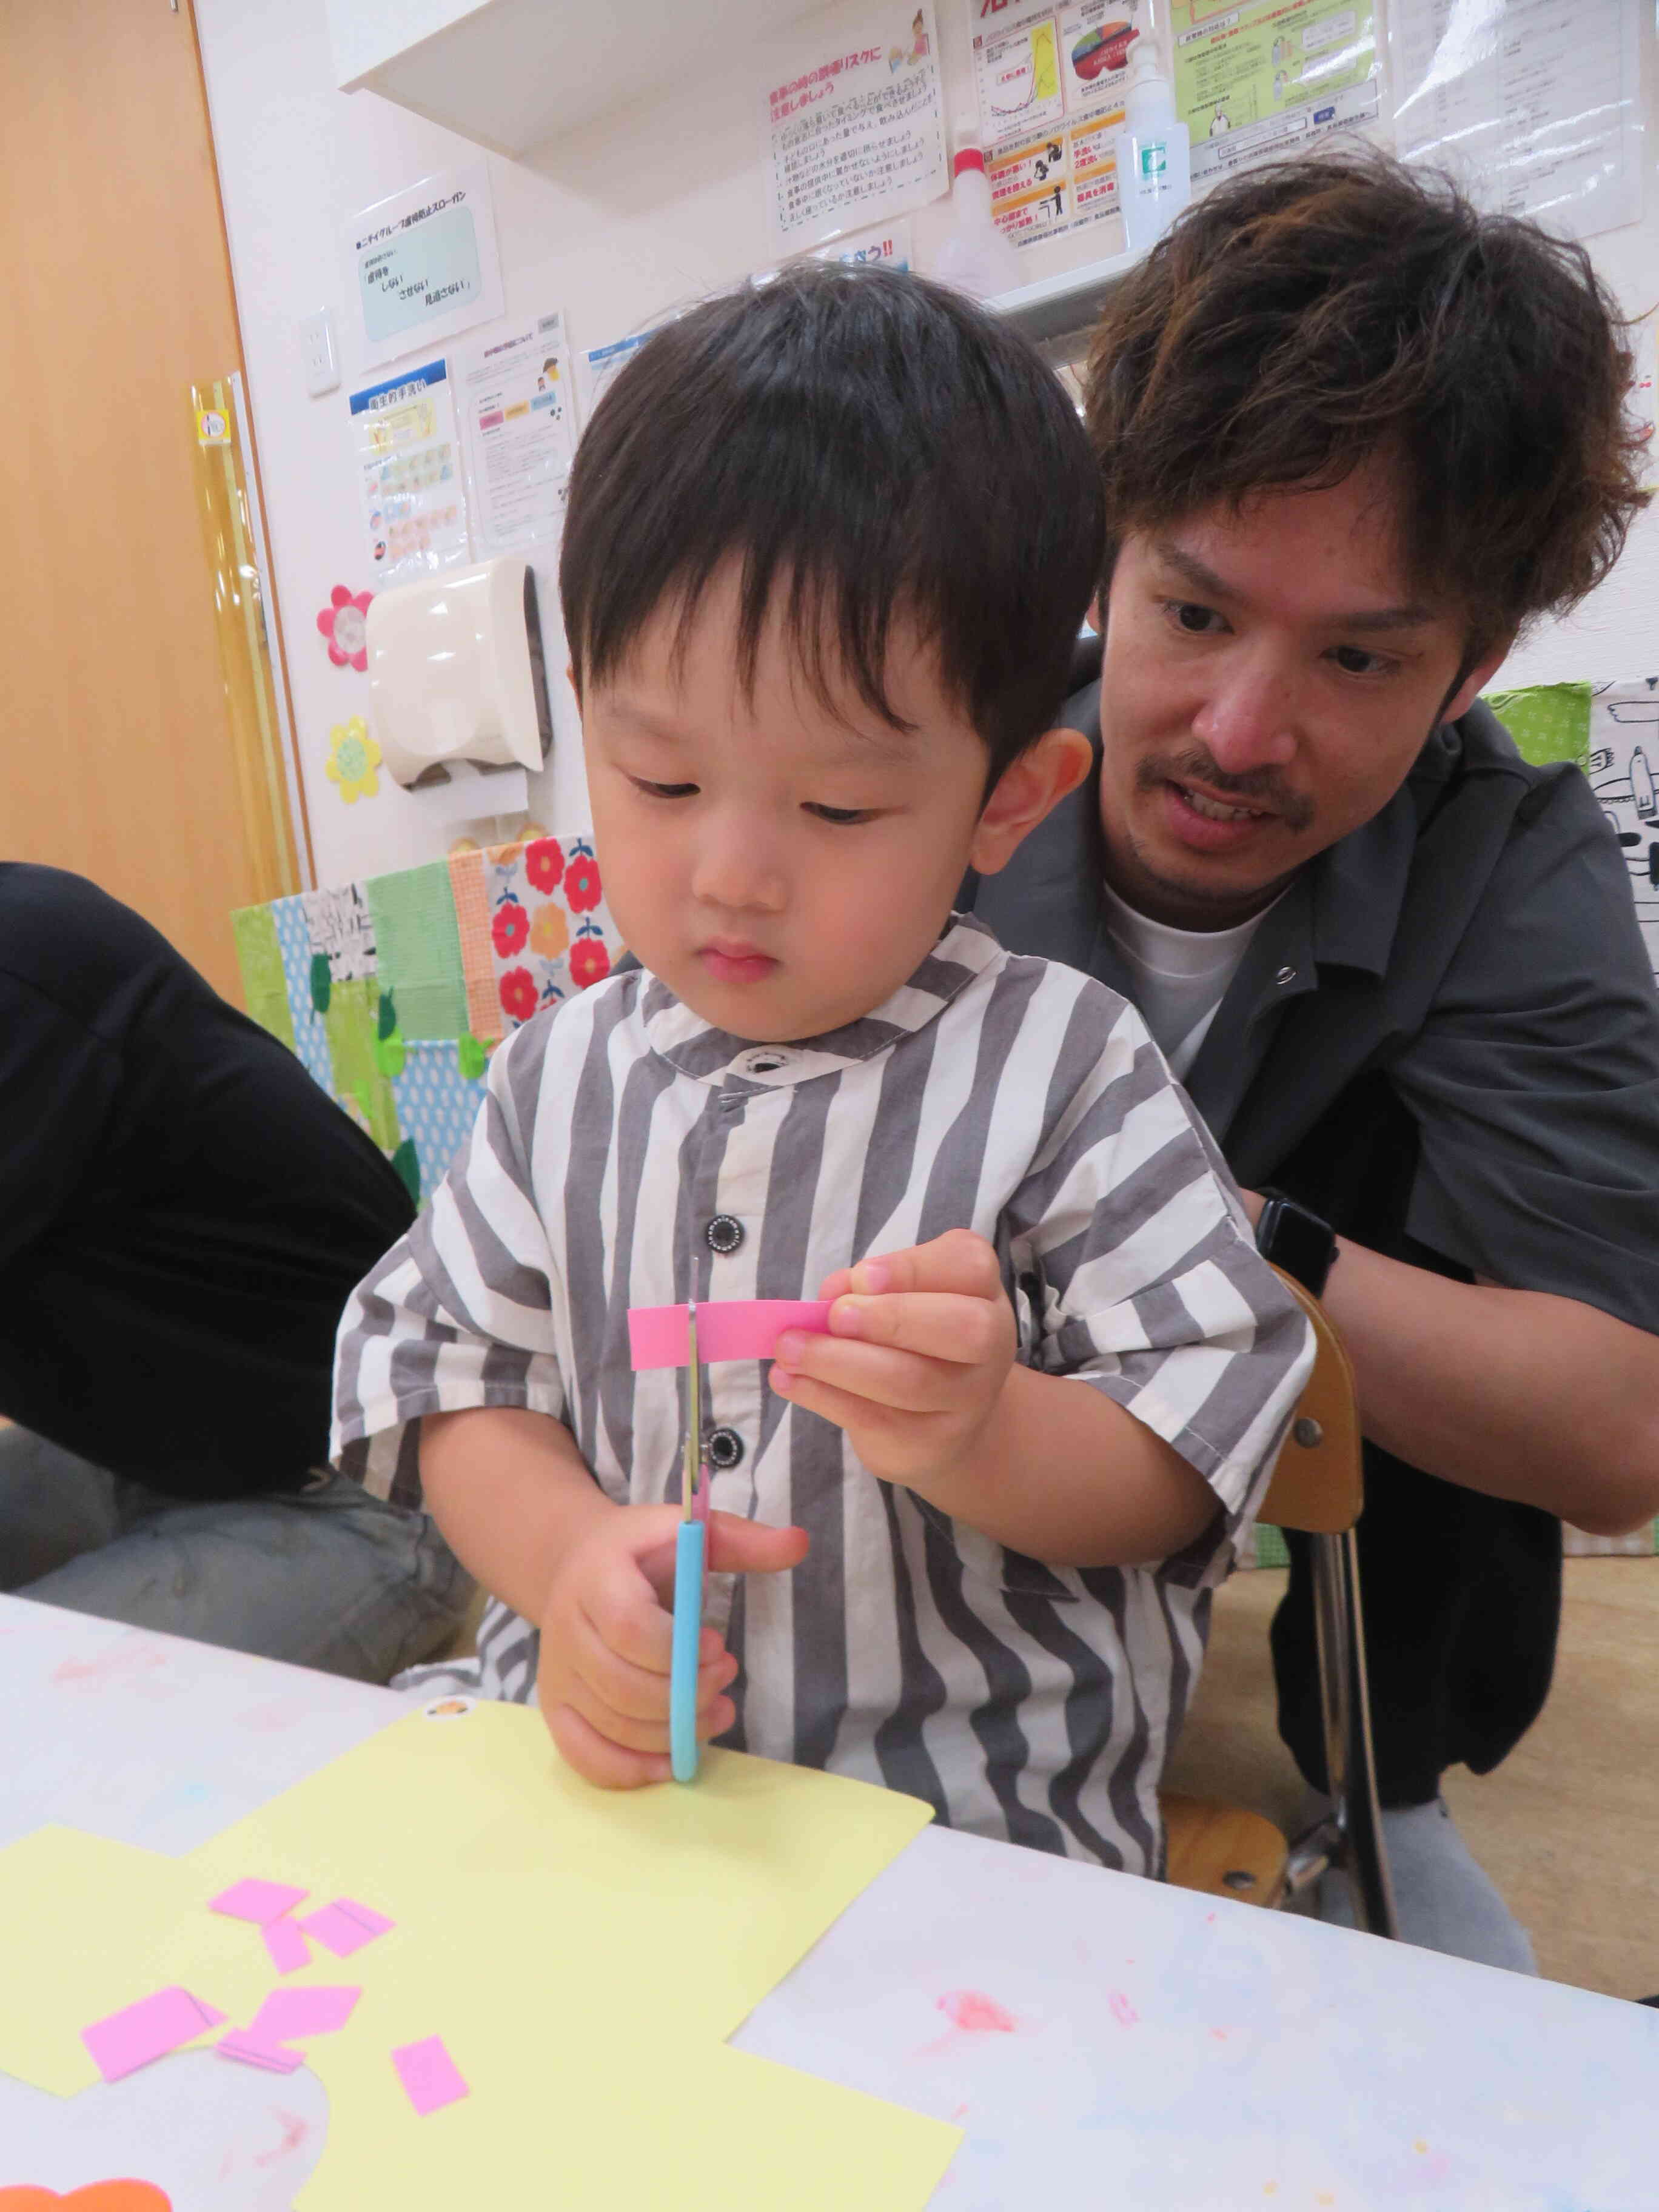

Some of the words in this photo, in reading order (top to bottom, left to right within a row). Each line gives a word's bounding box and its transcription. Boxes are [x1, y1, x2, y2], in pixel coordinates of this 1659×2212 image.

[999, 213, 1038, 234] っかり加熱!
